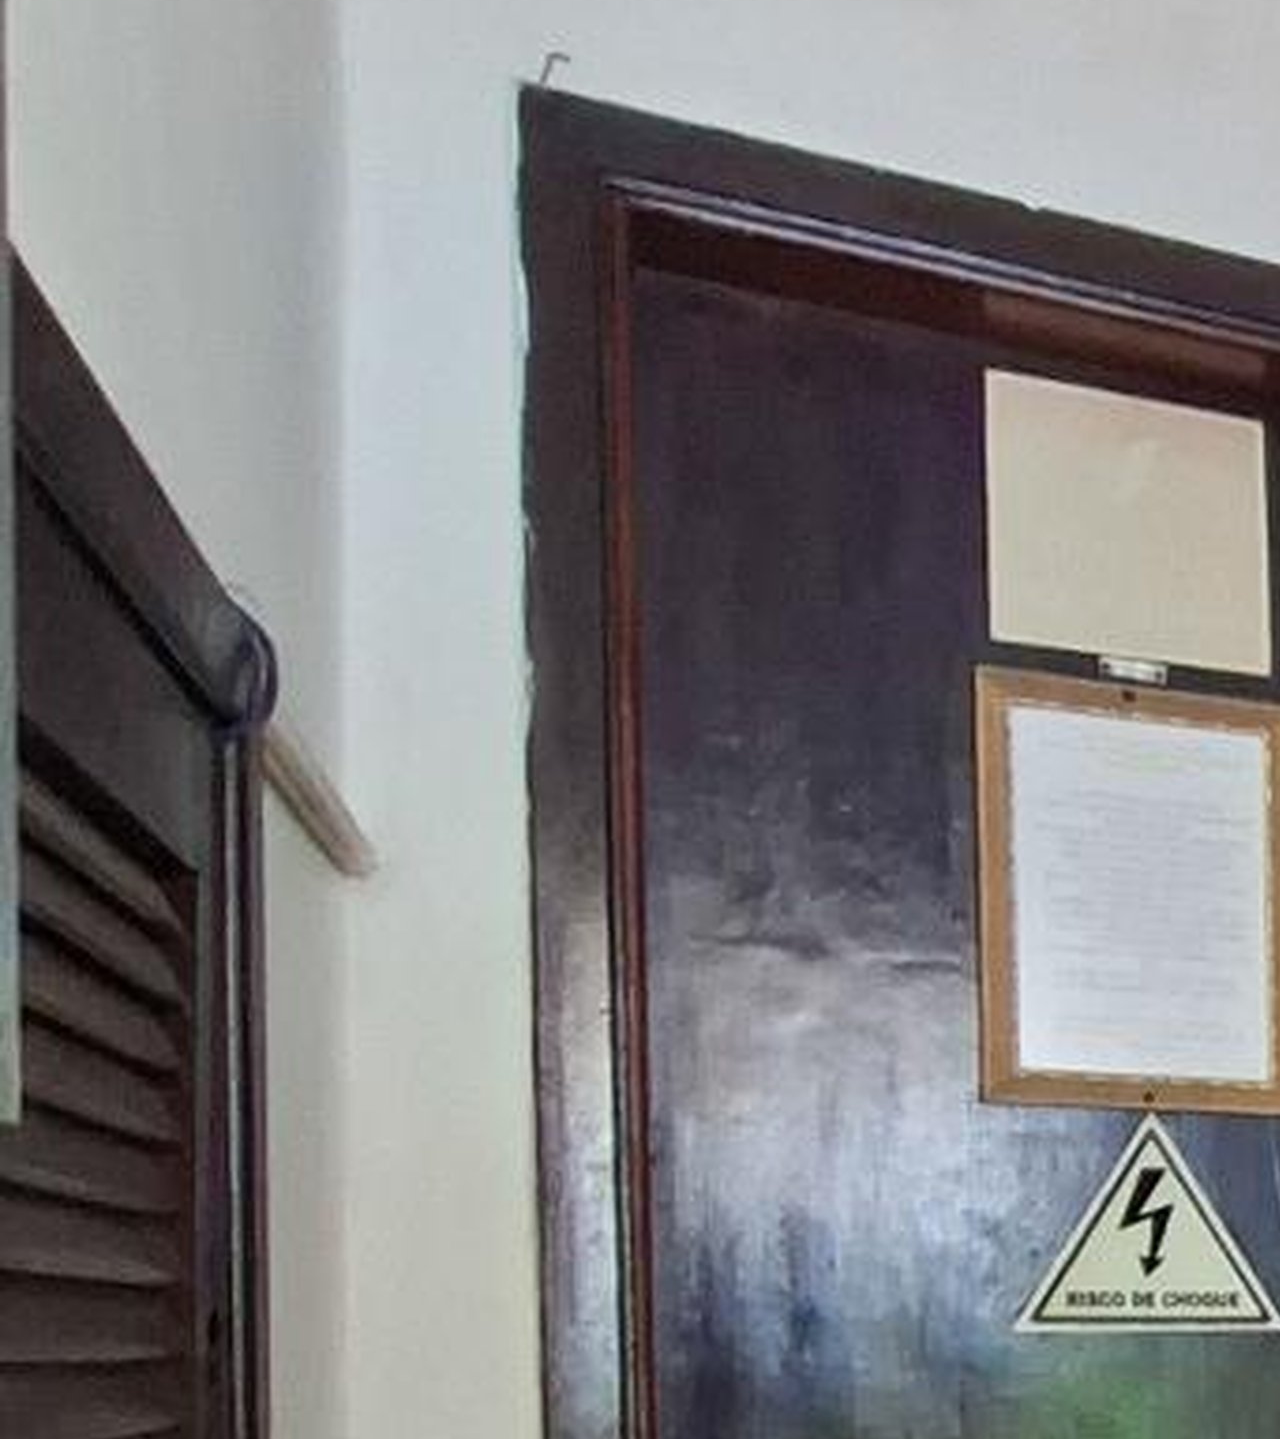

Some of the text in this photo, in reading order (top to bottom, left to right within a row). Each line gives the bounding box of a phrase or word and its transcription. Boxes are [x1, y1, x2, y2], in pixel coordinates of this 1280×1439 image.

[1065, 1290, 1239, 1309] RISCO DE CHOQUE
